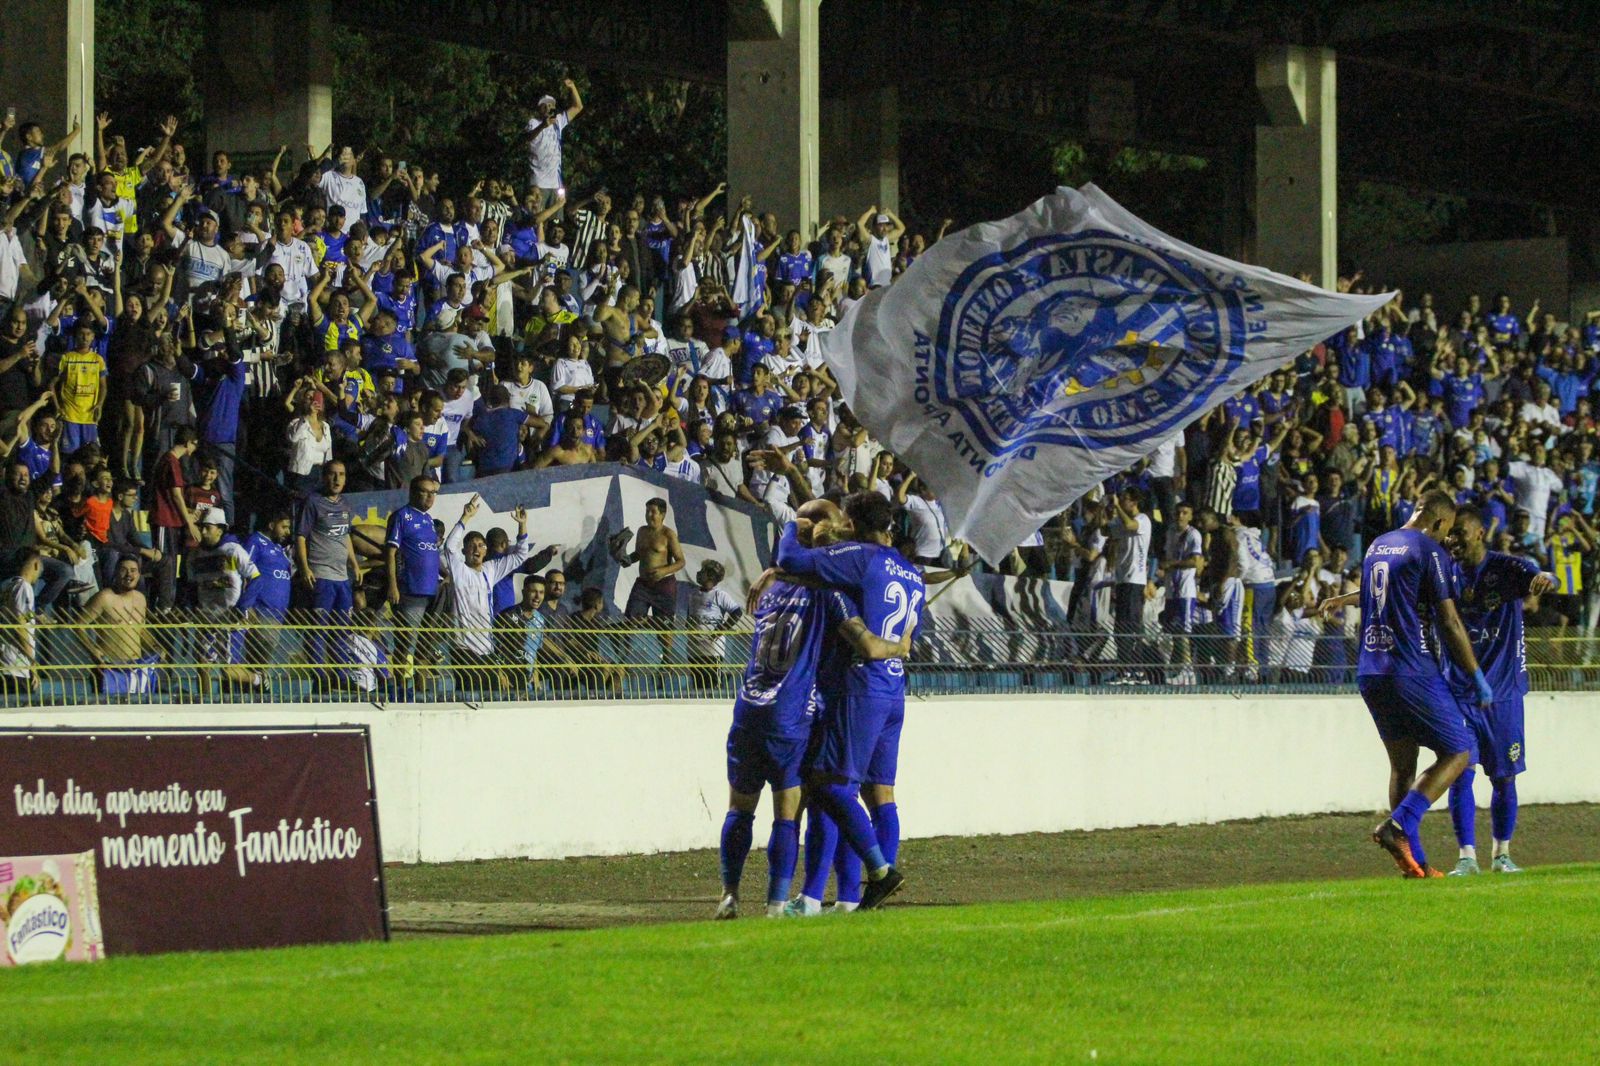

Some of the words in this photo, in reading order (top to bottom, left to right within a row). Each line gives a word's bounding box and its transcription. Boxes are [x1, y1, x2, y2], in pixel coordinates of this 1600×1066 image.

[1374, 545, 1408, 557] Sicredi
[1369, 561, 1389, 618] 9
[14, 778, 59, 816] todo
[62, 778, 102, 822] dia,
[106, 782, 193, 828] aproveite
[195, 789, 226, 814] seu
[102, 821, 226, 869] momento
[228, 807, 362, 877] Fantástico
